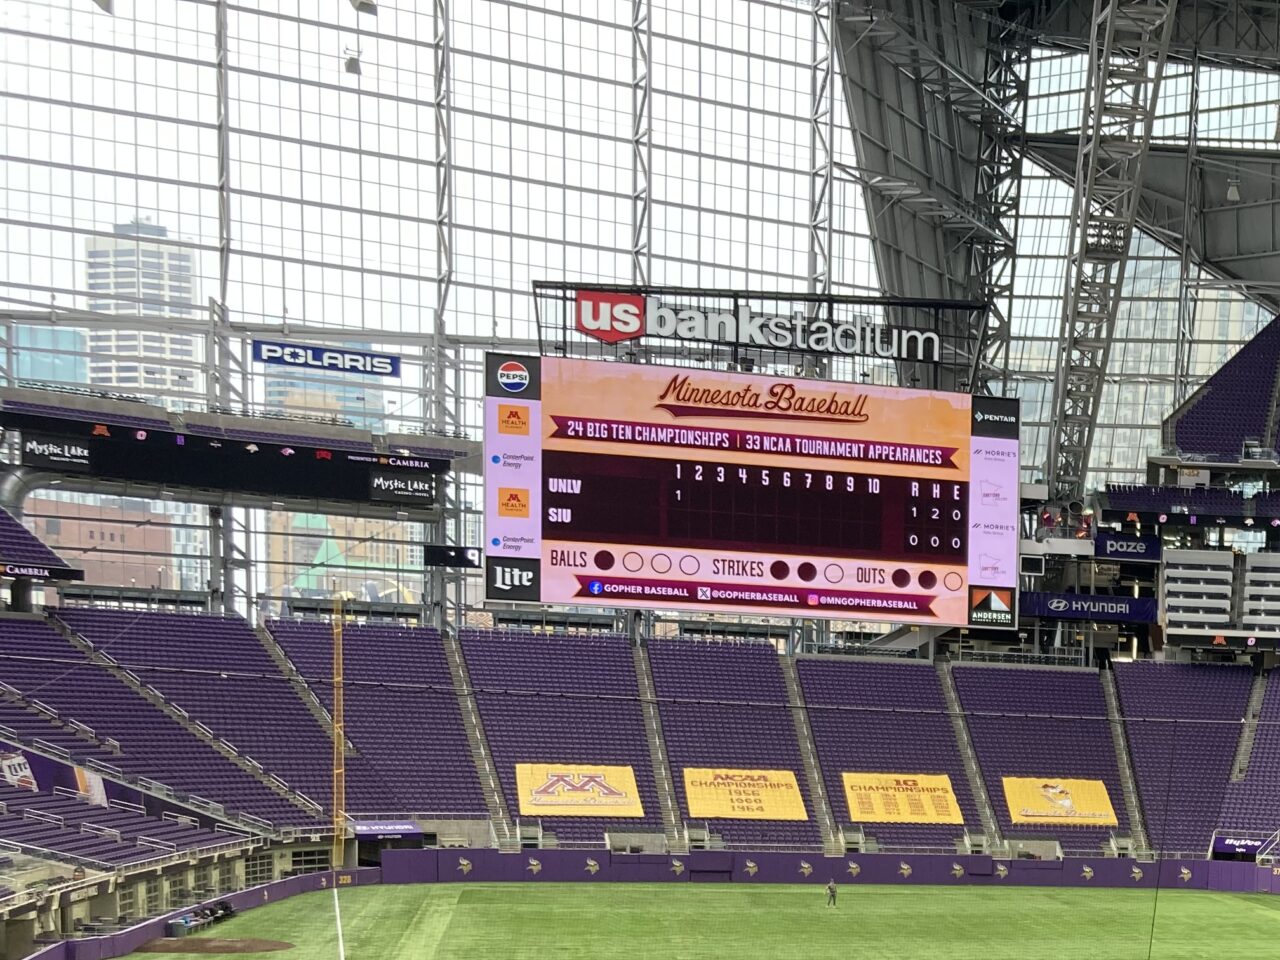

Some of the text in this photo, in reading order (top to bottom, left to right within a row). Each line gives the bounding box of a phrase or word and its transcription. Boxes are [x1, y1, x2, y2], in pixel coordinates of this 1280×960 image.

[261, 344, 393, 374] POLARIS
[500, 372, 527, 382] PEPSI
[659, 374, 869, 419] Minnesota Baseball
[502, 418, 527, 427] HEALTH
[984, 413, 1016, 423] PENTAIR
[25, 440, 63, 455] Mystic
[567, 420, 942, 464] 24 BIG TEN CHAMPIONSHIPS 33 NCAA TOURNAMENT APPEARANCES
[389, 457, 429, 468] CAMBRIA
[373, 477, 406, 490] Mystic
[676, 464, 960, 500] 1 2 3 4 5 6 7 8 9 10 R H E
[502, 501, 527, 509] HEALTH
[548, 478, 961, 521] UNLV 1 1 2 0
[548, 508, 961, 549] SIU 0 0 0
[983, 523, 1016, 531] MORRIE'S
[1106, 540, 1146, 554] paze
[5, 565, 49, 577] CAMBRIA
[550, 550, 885, 584] BALLS STRIKES OUTS
[494, 566, 533, 590] Lite
[604, 584, 918, 610] GOPHER BASEBALL @GOPHERBASEBALL @MNGOPHERBASEBALL
[1071, 600, 1129, 614] HYUNDAI
[972, 612, 1011, 620] ANDERSEN
[691, 780, 793, 790] CHAMPIONSHIPS
[850, 785, 949, 794] CHAMPIONSHIPS
